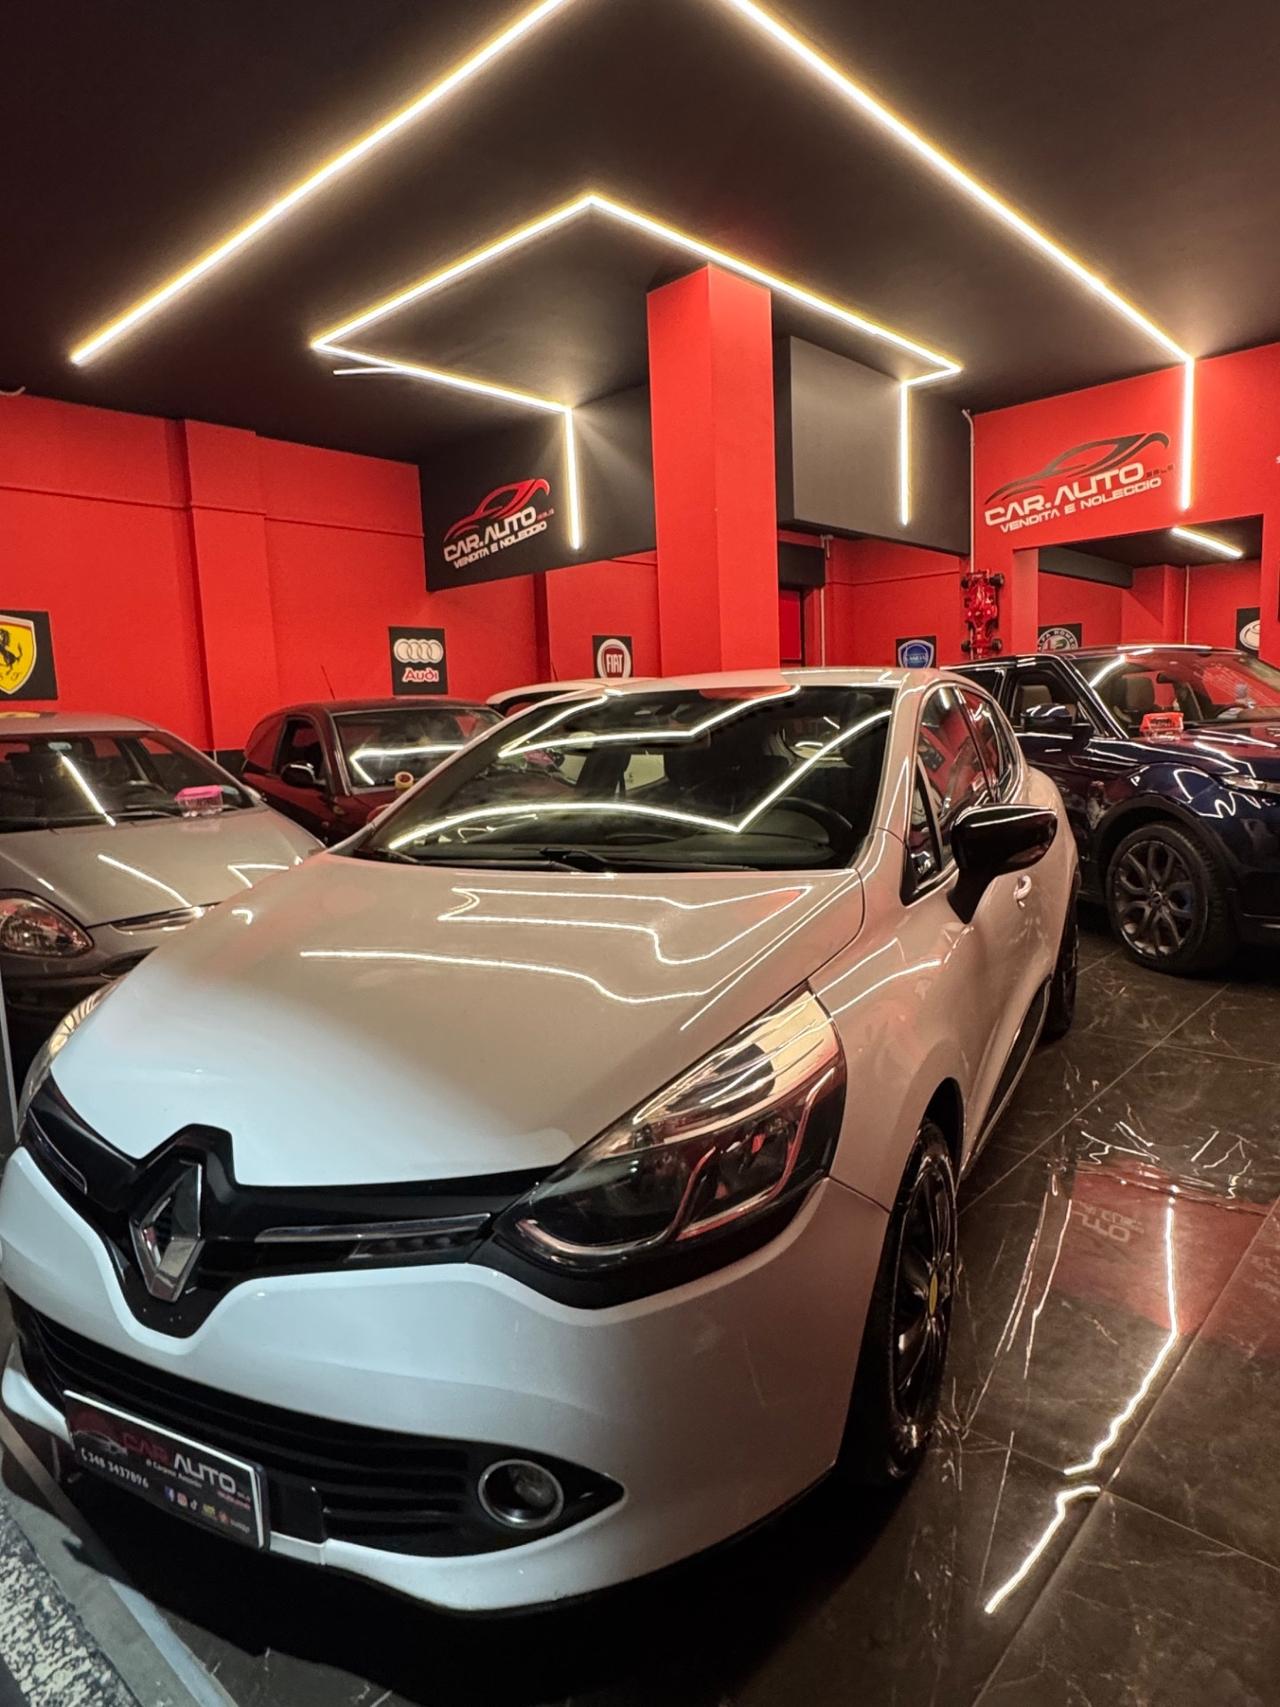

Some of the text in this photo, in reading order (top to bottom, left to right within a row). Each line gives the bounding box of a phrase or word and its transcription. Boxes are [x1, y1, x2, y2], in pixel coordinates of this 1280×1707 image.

[1000, 510, 1060, 533] VENDITA
[1064, 503, 1076, 515] E
[453, 548, 490, 569] VENDITA
[490, 543, 499, 553] E
[1053, 630, 1076, 650] ROMEO
[402, 667, 440, 683] Audi
[606, 653, 624, 674] FIAT
[174, 1453, 236, 1494] AUTO
